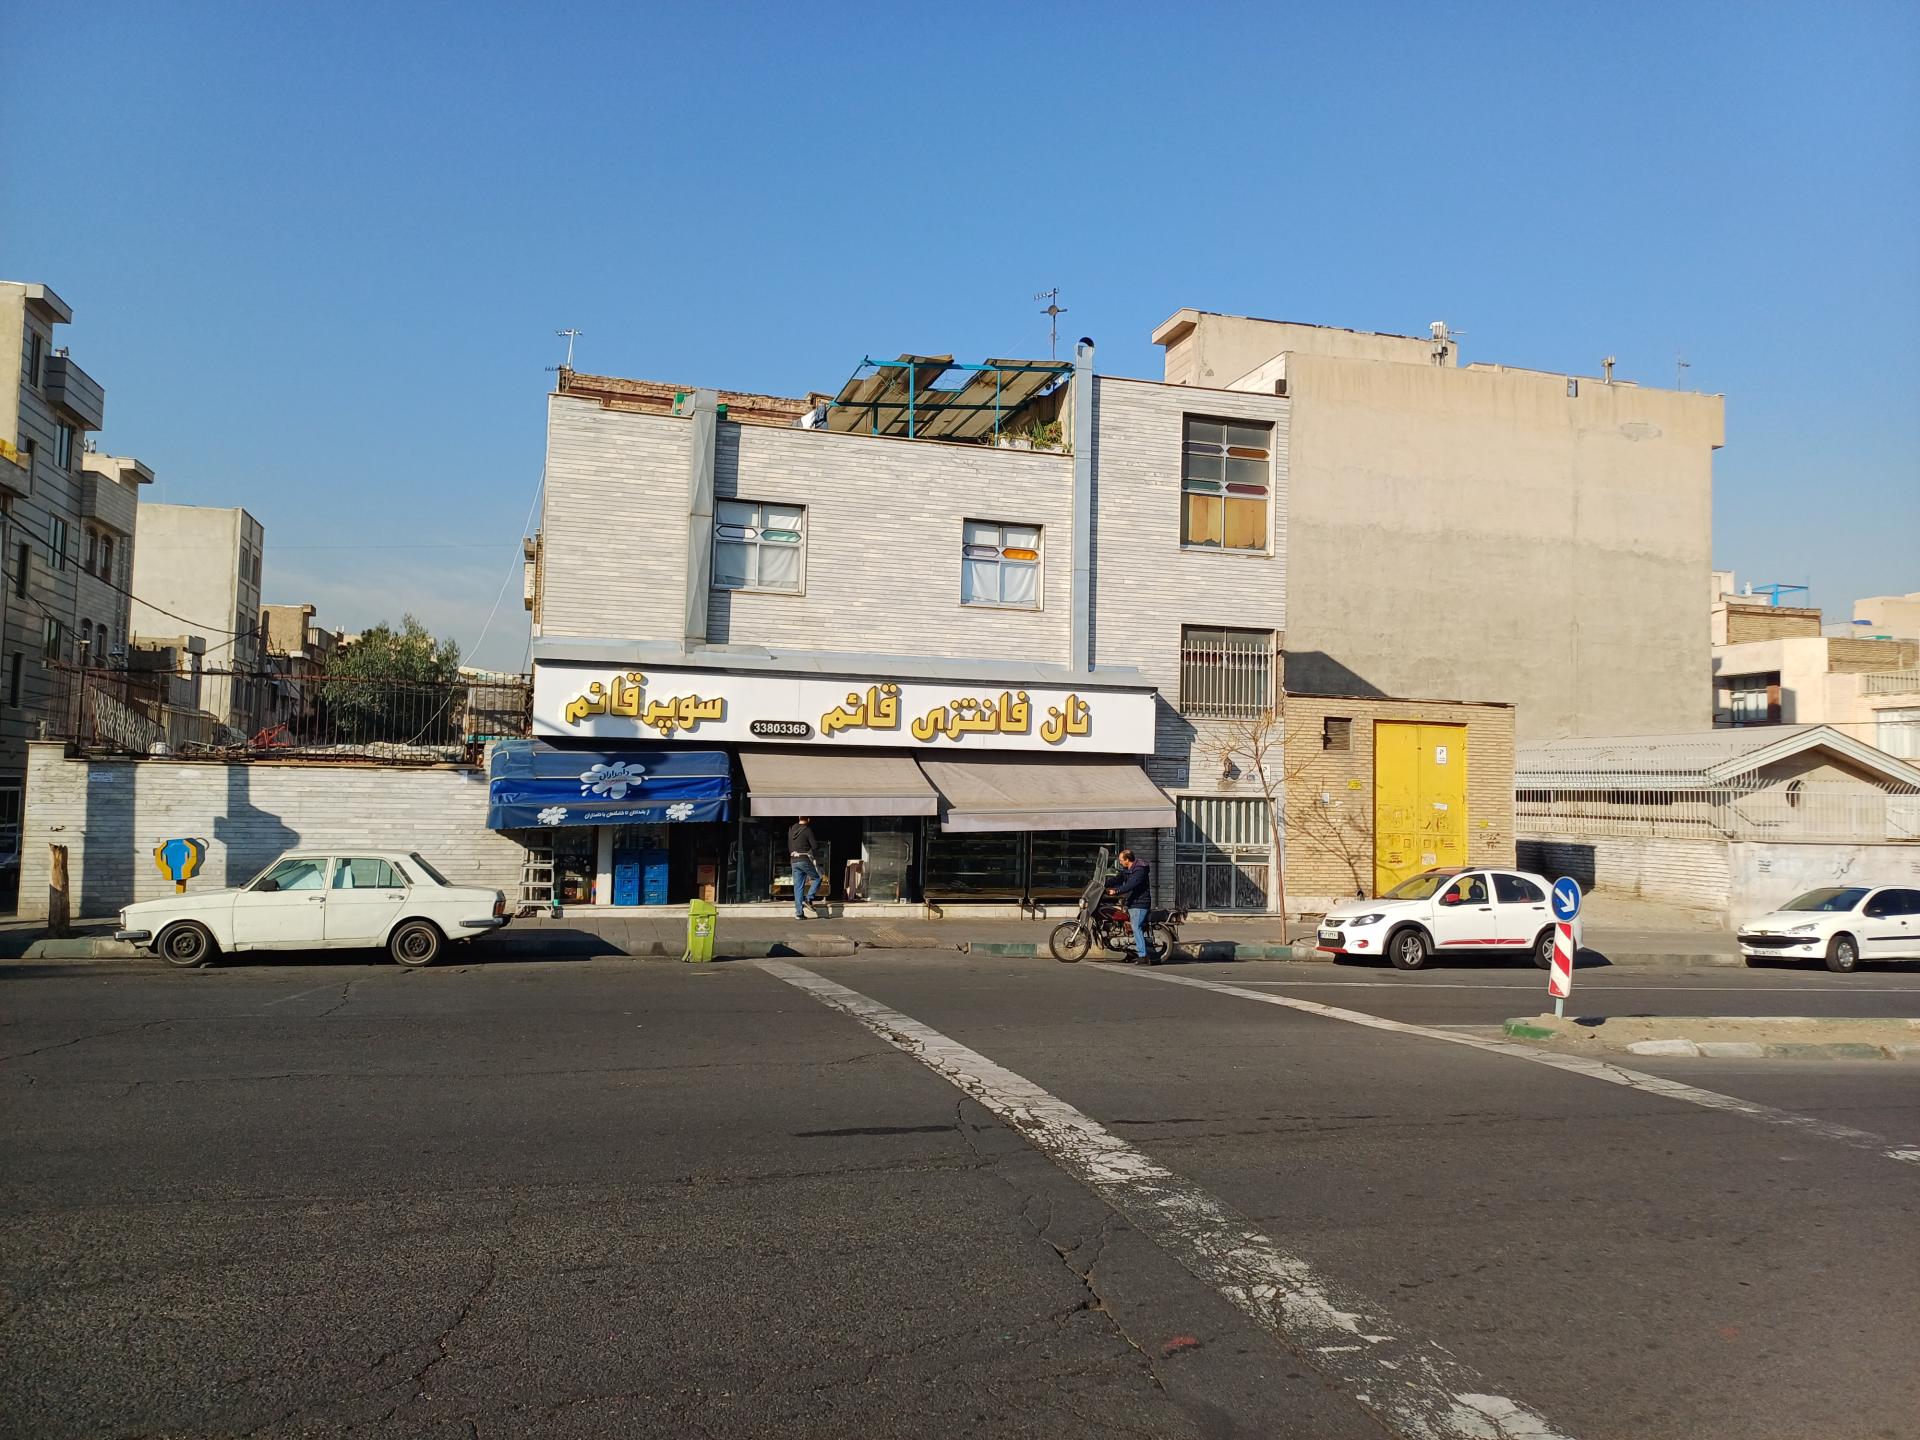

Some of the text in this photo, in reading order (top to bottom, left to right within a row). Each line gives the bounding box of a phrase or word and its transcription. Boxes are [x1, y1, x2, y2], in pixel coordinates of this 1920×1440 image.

[566, 672, 724, 736] سوپر قائم
[753, 722, 807, 735] 33803368
[820, 682, 1089, 742] نان فانتزی قائم
